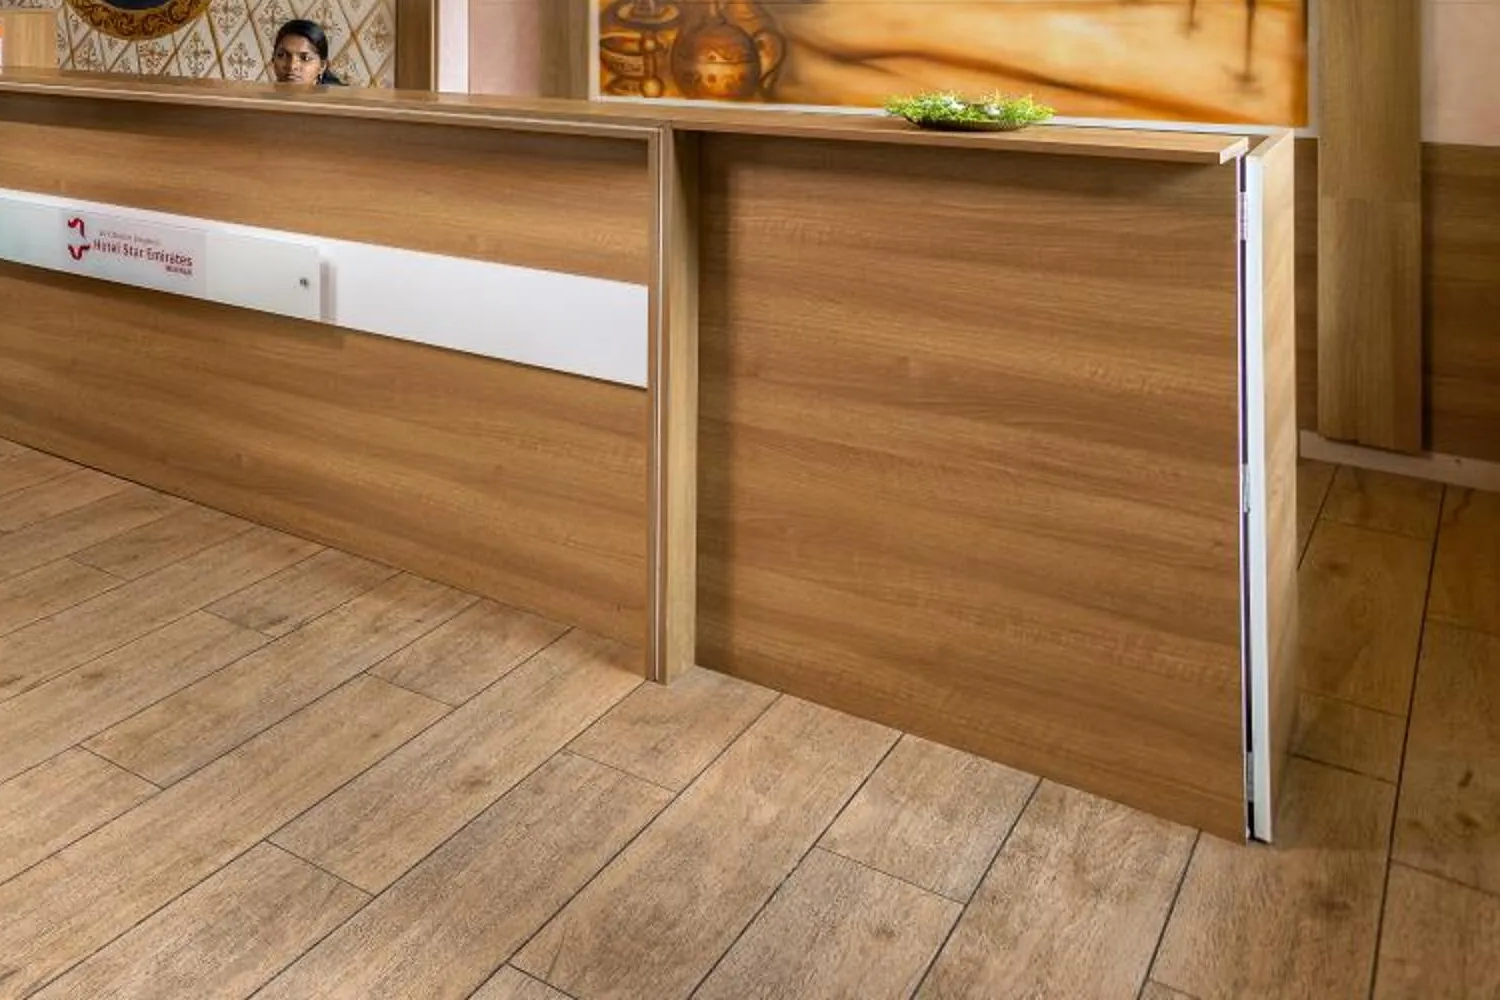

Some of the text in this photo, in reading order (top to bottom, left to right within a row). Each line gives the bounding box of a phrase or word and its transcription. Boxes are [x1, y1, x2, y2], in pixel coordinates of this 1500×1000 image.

[93, 239, 193, 267] Hotel Star Emirates
